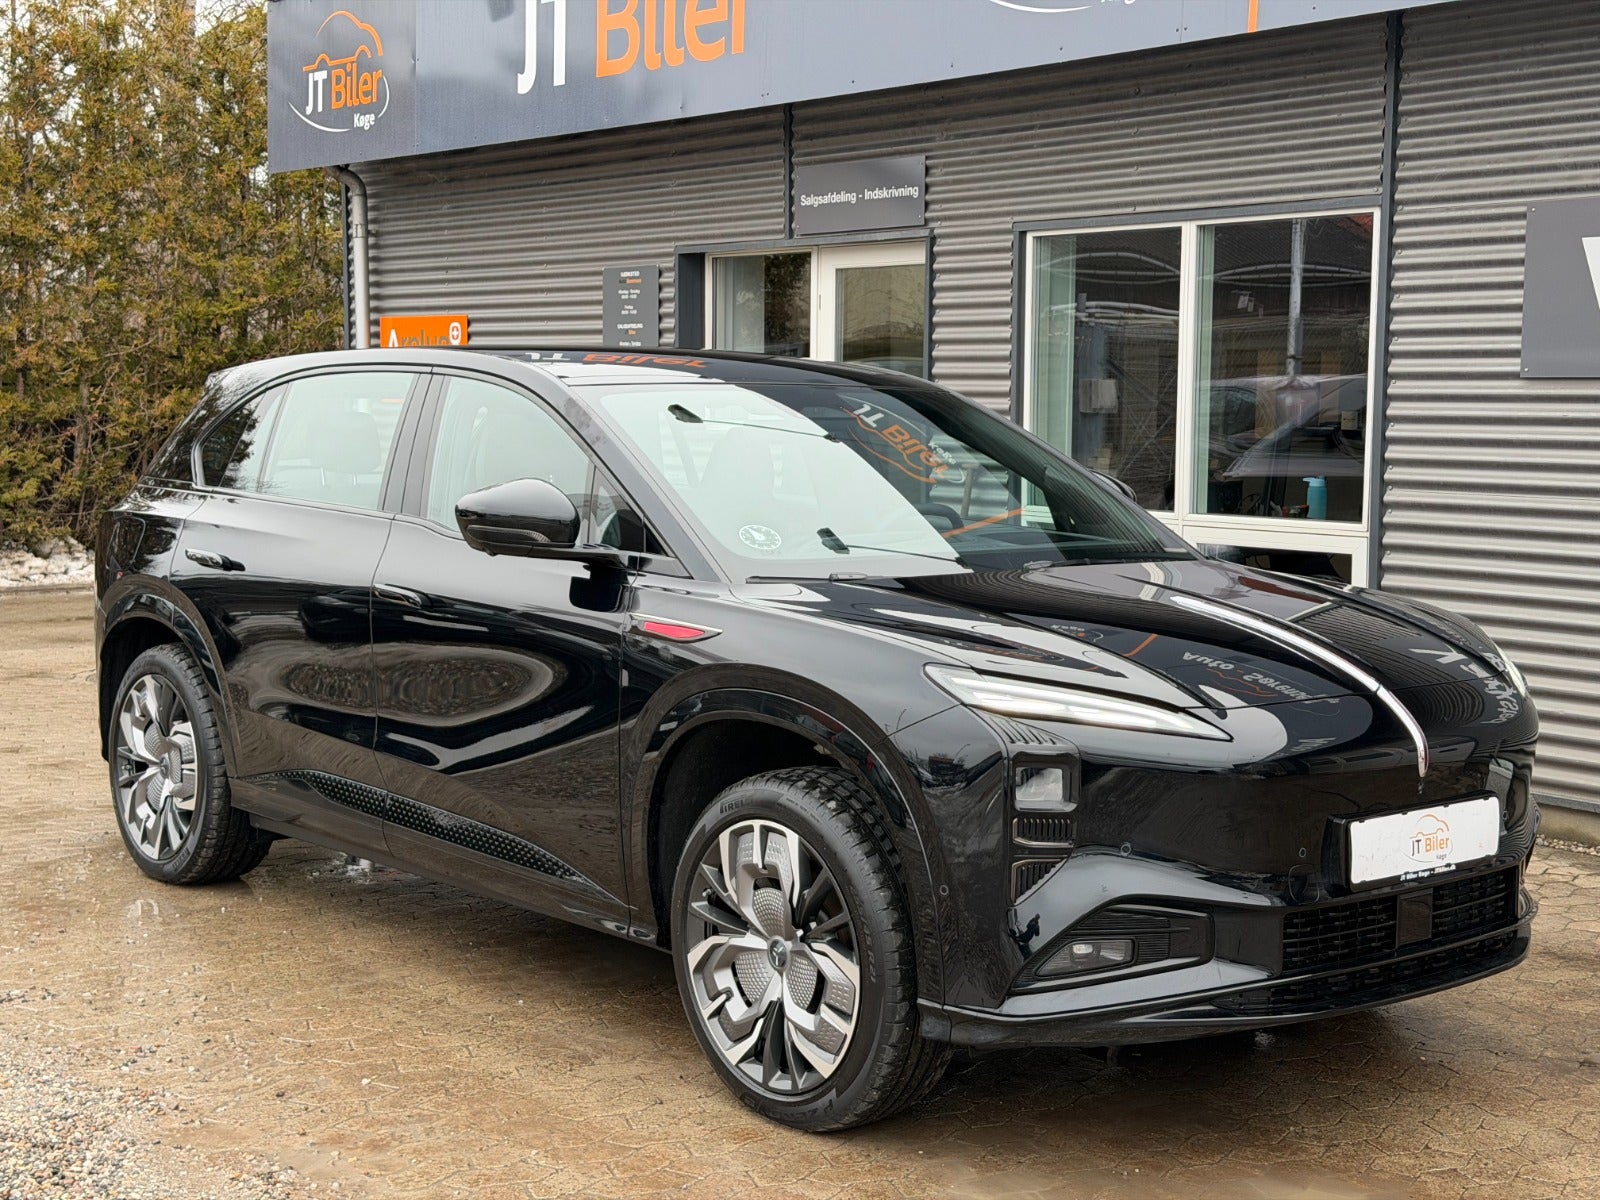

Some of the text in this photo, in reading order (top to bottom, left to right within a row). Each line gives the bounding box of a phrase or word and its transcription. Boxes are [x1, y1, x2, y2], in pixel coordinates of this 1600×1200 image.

[306, 62, 382, 115] JT Biler
[353, 112, 375, 130] Køge
[800, 191, 857, 207] Salgsafdeling
[864, 184, 919, 200] Indskrivning
[1411, 835, 1450, 857] JT Biler
